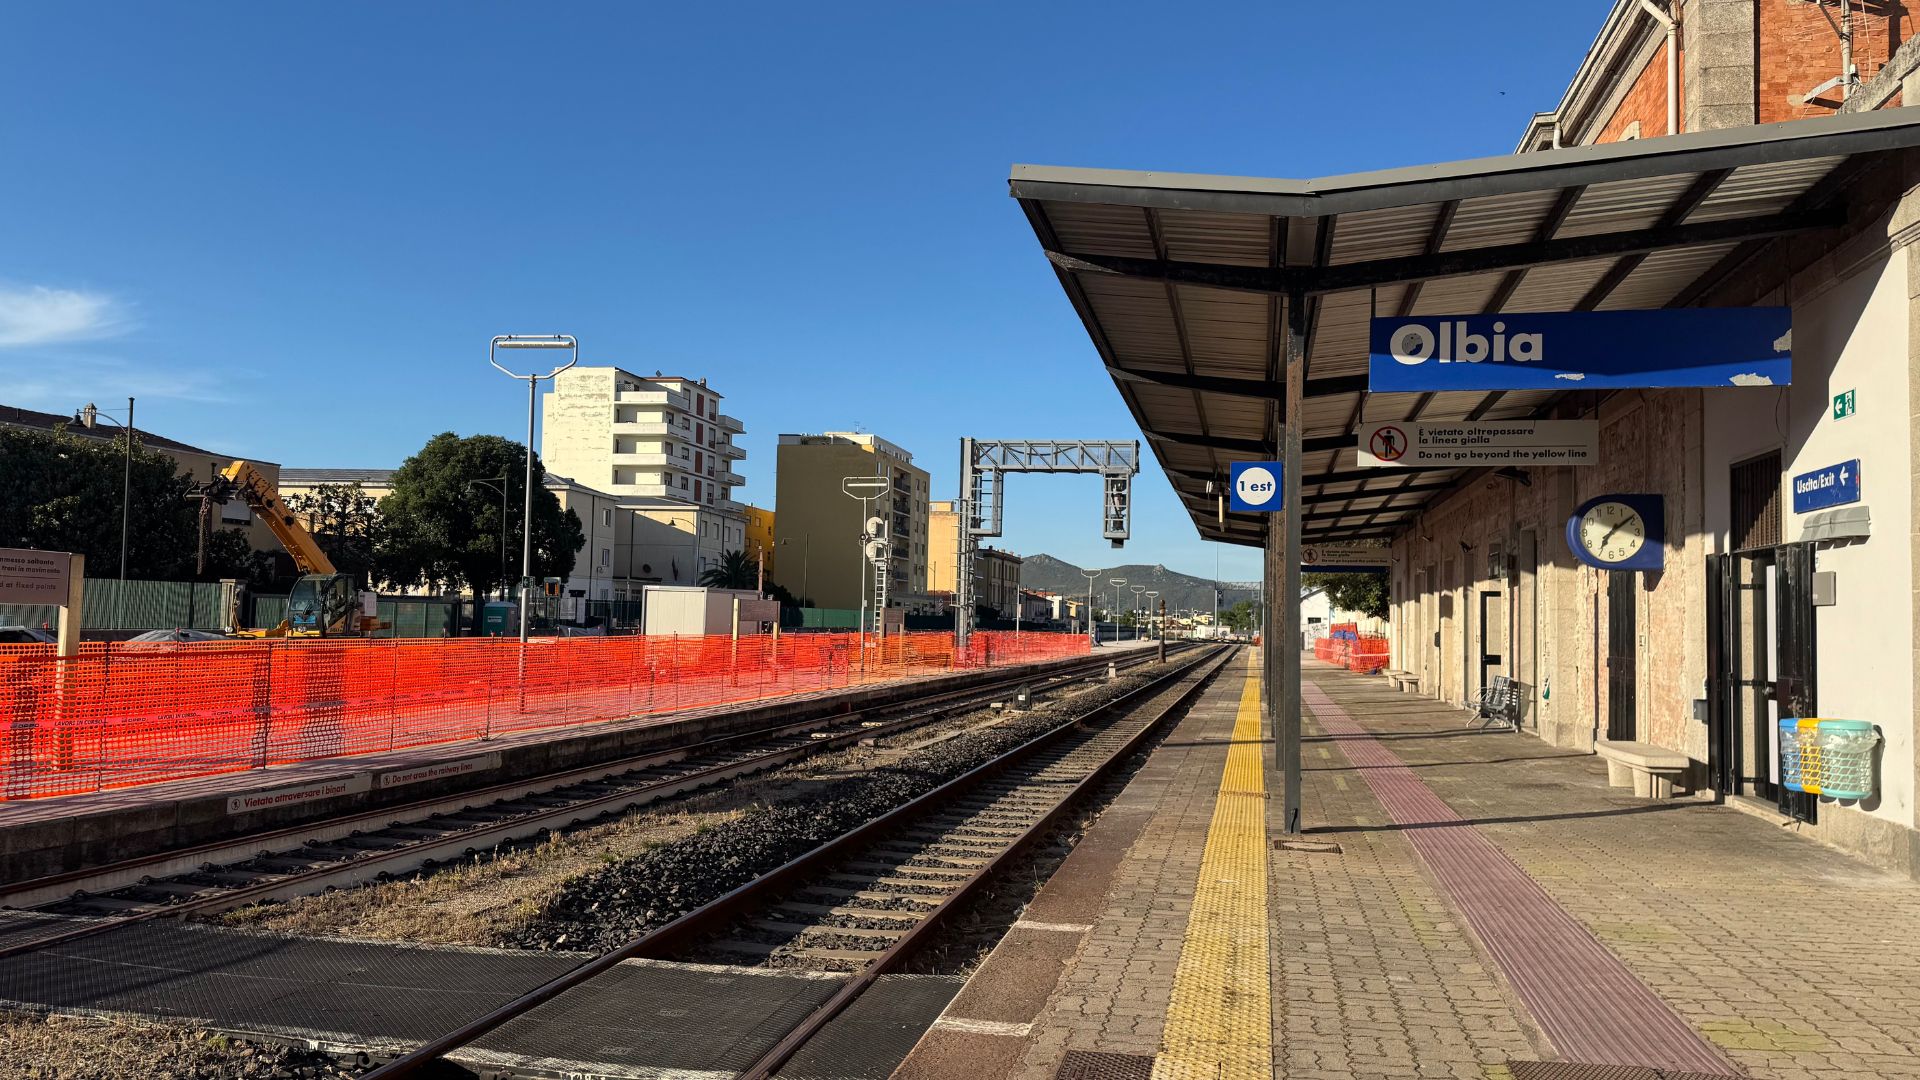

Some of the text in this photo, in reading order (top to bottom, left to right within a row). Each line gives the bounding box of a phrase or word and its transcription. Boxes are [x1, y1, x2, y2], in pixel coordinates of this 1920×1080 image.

[1389, 320, 1543, 366] Olbia
[1418, 426, 1534, 437] È vietato oltrepassare
[1418, 435, 1490, 446] la linea gialla
[1418, 449, 1587, 460] Do not go beyond the yellow line
[1239, 480, 1272, 492] 1 est
[1797, 472, 1835, 494] Uscita/Exit
[1596, 508, 1602, 518] 11
[1606, 505, 1615, 515] 12
[1586, 517, 1594, 526] 10
[1582, 528, 1588, 538] 9
[1634, 528, 1641, 537] 3
[1586, 539, 1593, 549] 8
[1629, 539, 1636, 548] 4
[1608, 550, 1615, 560] 6
[1619, 547, 1625, 557] 5
[27, 558, 55, 566] soltanto
[16, 581, 34, 589] fixed
[392, 763, 473, 784] Do not cross the railway lines
[244, 797, 273, 808] Vietato
[275, 788, 321, 804] attraversare
[325, 783, 347, 795] binari
